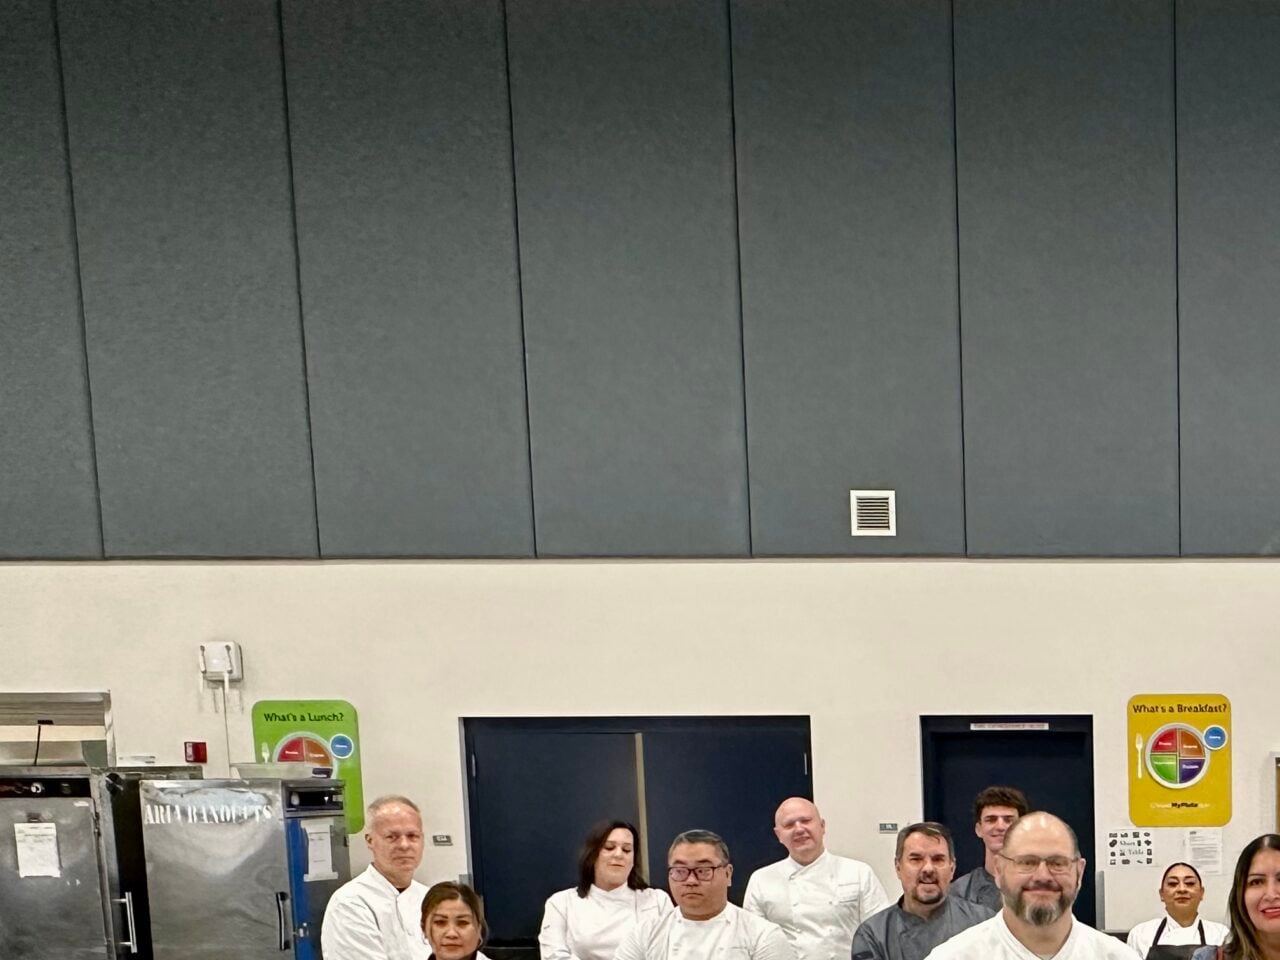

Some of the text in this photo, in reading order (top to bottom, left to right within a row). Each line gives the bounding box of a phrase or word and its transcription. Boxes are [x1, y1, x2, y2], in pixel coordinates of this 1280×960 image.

[1132, 703, 1166, 713] What's
[1177, 703, 1228, 713] Breakfast?
[263, 712, 344, 722] What's a Lunch?
[143, 804, 182, 824] ARIA
